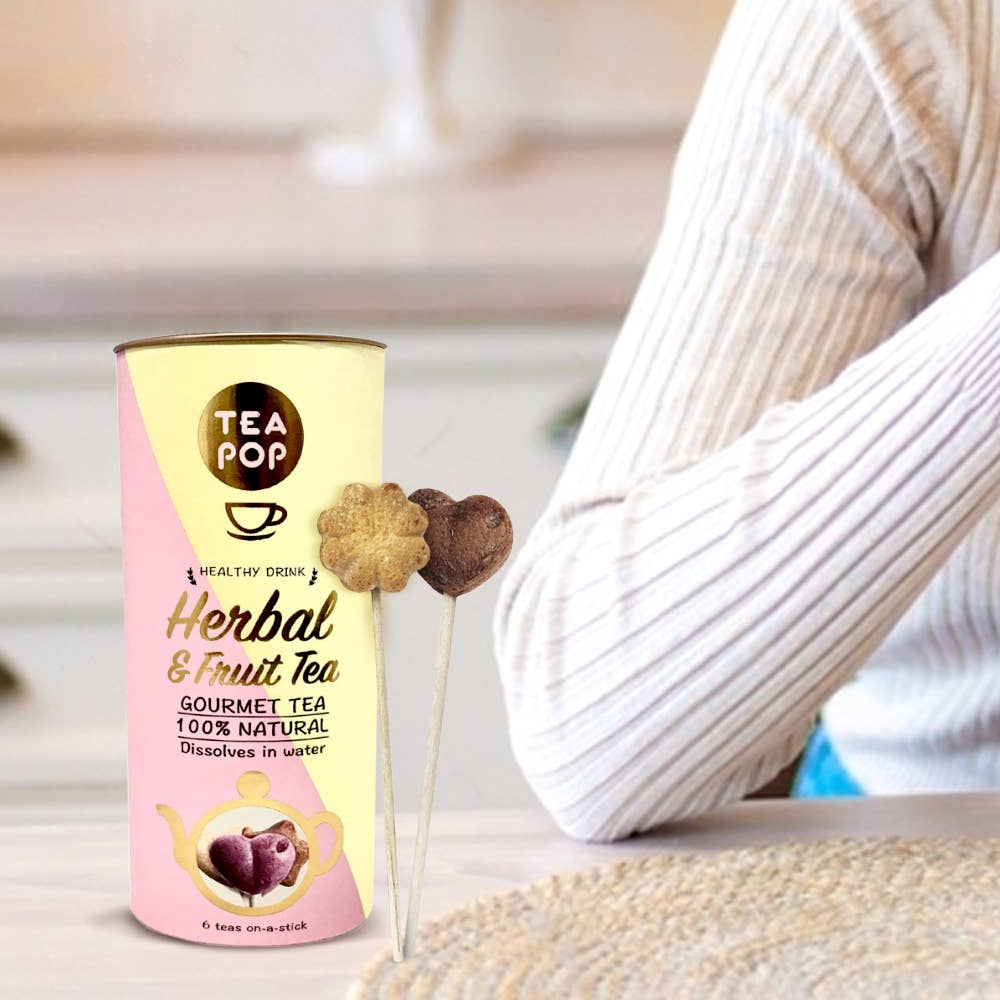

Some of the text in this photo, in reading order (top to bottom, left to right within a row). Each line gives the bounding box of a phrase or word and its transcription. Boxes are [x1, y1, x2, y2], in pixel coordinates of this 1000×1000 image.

[214, 410, 288, 436] TEA
[217, 441, 288, 471] POP
[199, 566, 306, 578] HEALTHY DRINK
[166, 589, 338, 642] Herbal
[167, 649, 341, 687] & Fruit Tea
[180, 695, 326, 714] GOURMET TEA
[176, 717, 329, 737] 100% NATURAL
[180, 741, 327, 758] Dissolves in water
[202, 919, 308, 933] 6 teas on-a-stick
